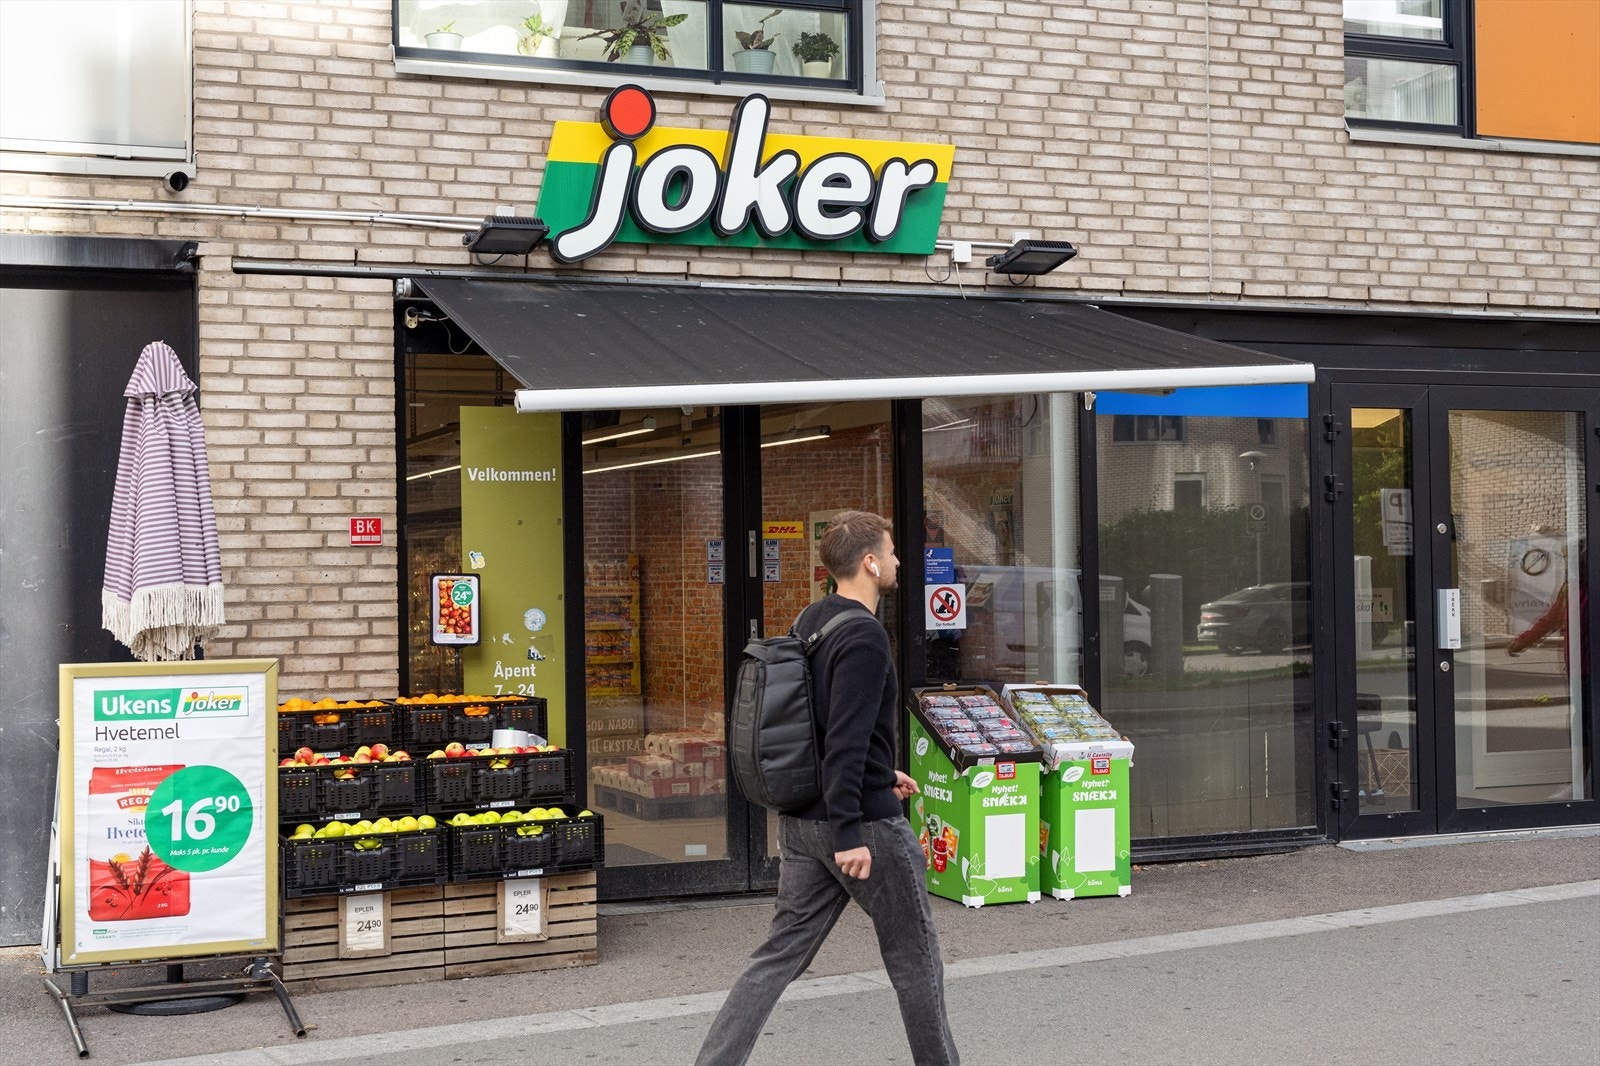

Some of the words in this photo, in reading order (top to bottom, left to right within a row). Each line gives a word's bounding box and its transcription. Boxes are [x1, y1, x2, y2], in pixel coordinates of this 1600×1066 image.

[548, 83, 938, 264] joker
[467, 467, 556, 481] Velkommen!
[356, 520, 376, 534] BK
[767, 526, 798, 534] DHL
[494, 660, 536, 680] Åpent
[494, 684, 503, 696] 7
[518, 683, 536, 697] 24
[101, 694, 172, 716] Ukens
[184, 691, 238, 716] joker
[95, 722, 180, 741] Hvetemel
[608, 718, 634, 731] NABO
[603, 739, 641, 753] EKSTRA
[928, 770, 948, 784] Nyhet!
[1081, 779, 1108, 789] Nyhet!
[991, 784, 1019, 794] Nyhet!
[120, 797, 150, 807] REGA
[128, 818, 145, 826] Sikt
[107, 827, 146, 840] Hvete
[211, 846, 229, 854] kunde
